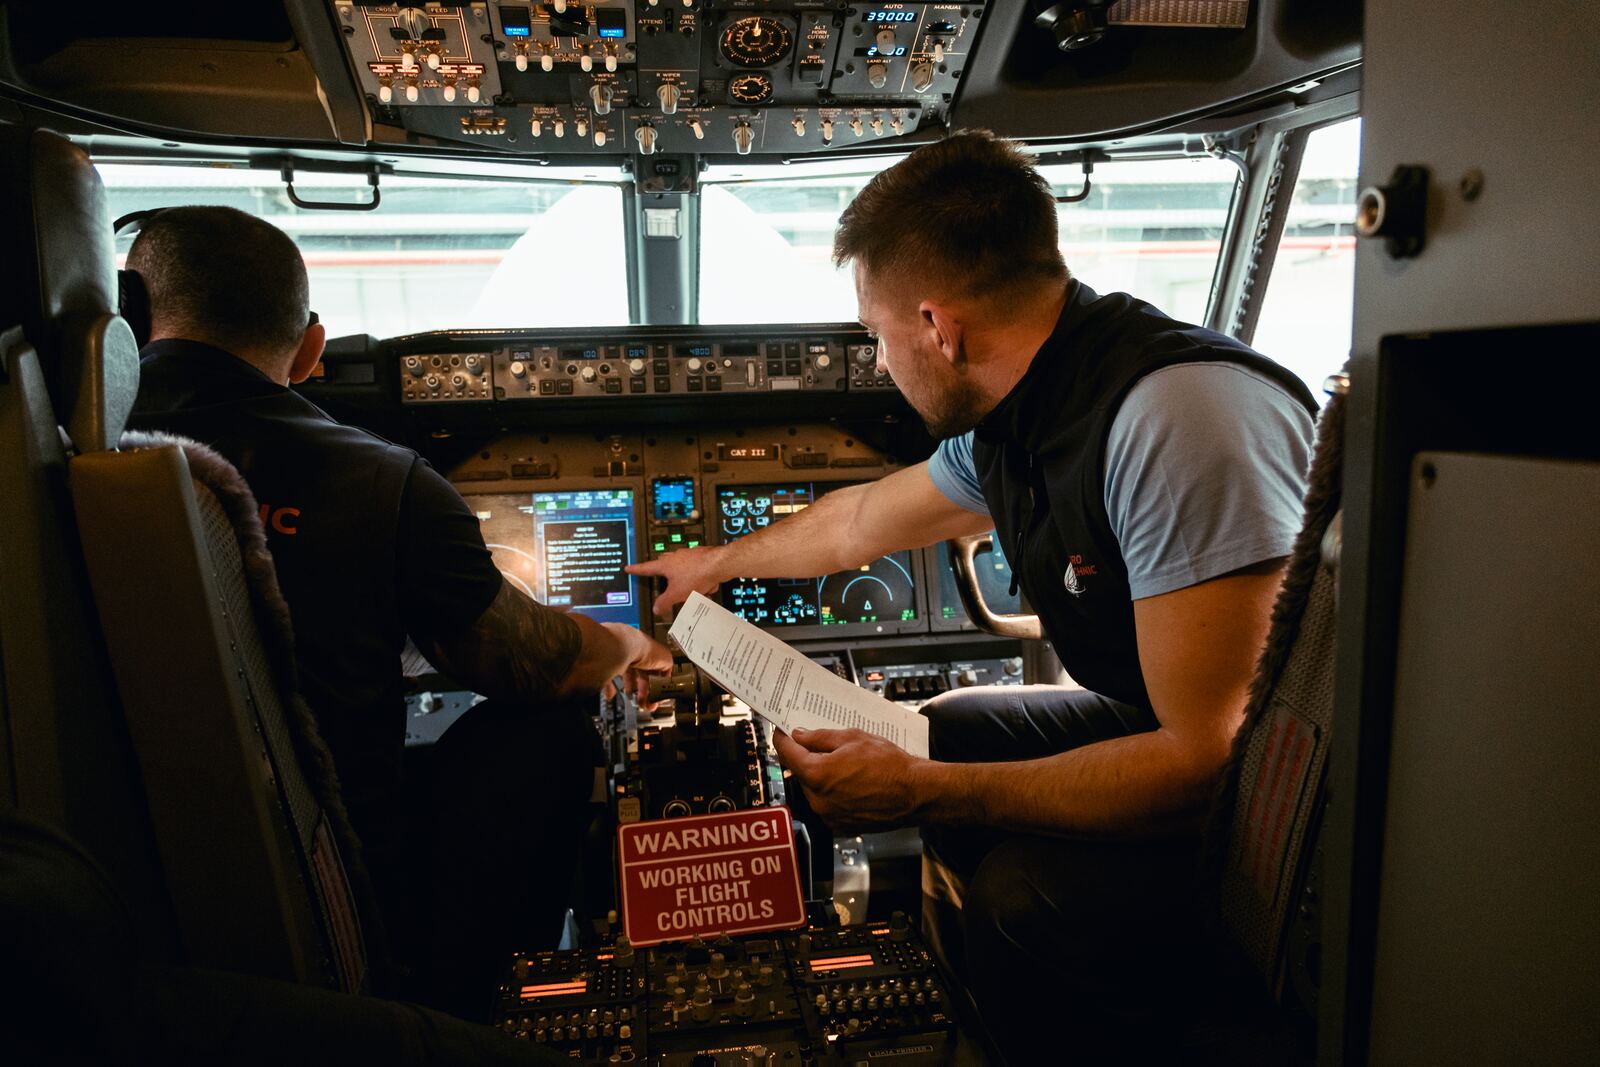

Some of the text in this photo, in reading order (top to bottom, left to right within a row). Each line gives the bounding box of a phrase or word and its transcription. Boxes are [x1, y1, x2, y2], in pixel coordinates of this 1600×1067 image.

[867, 12, 915, 21] 39000
[633, 819, 779, 855] WARNING!
[639, 855, 782, 889] WORKING ON
[676, 880, 751, 906] FLIGHT
[657, 899, 775, 931] CONTROLS
